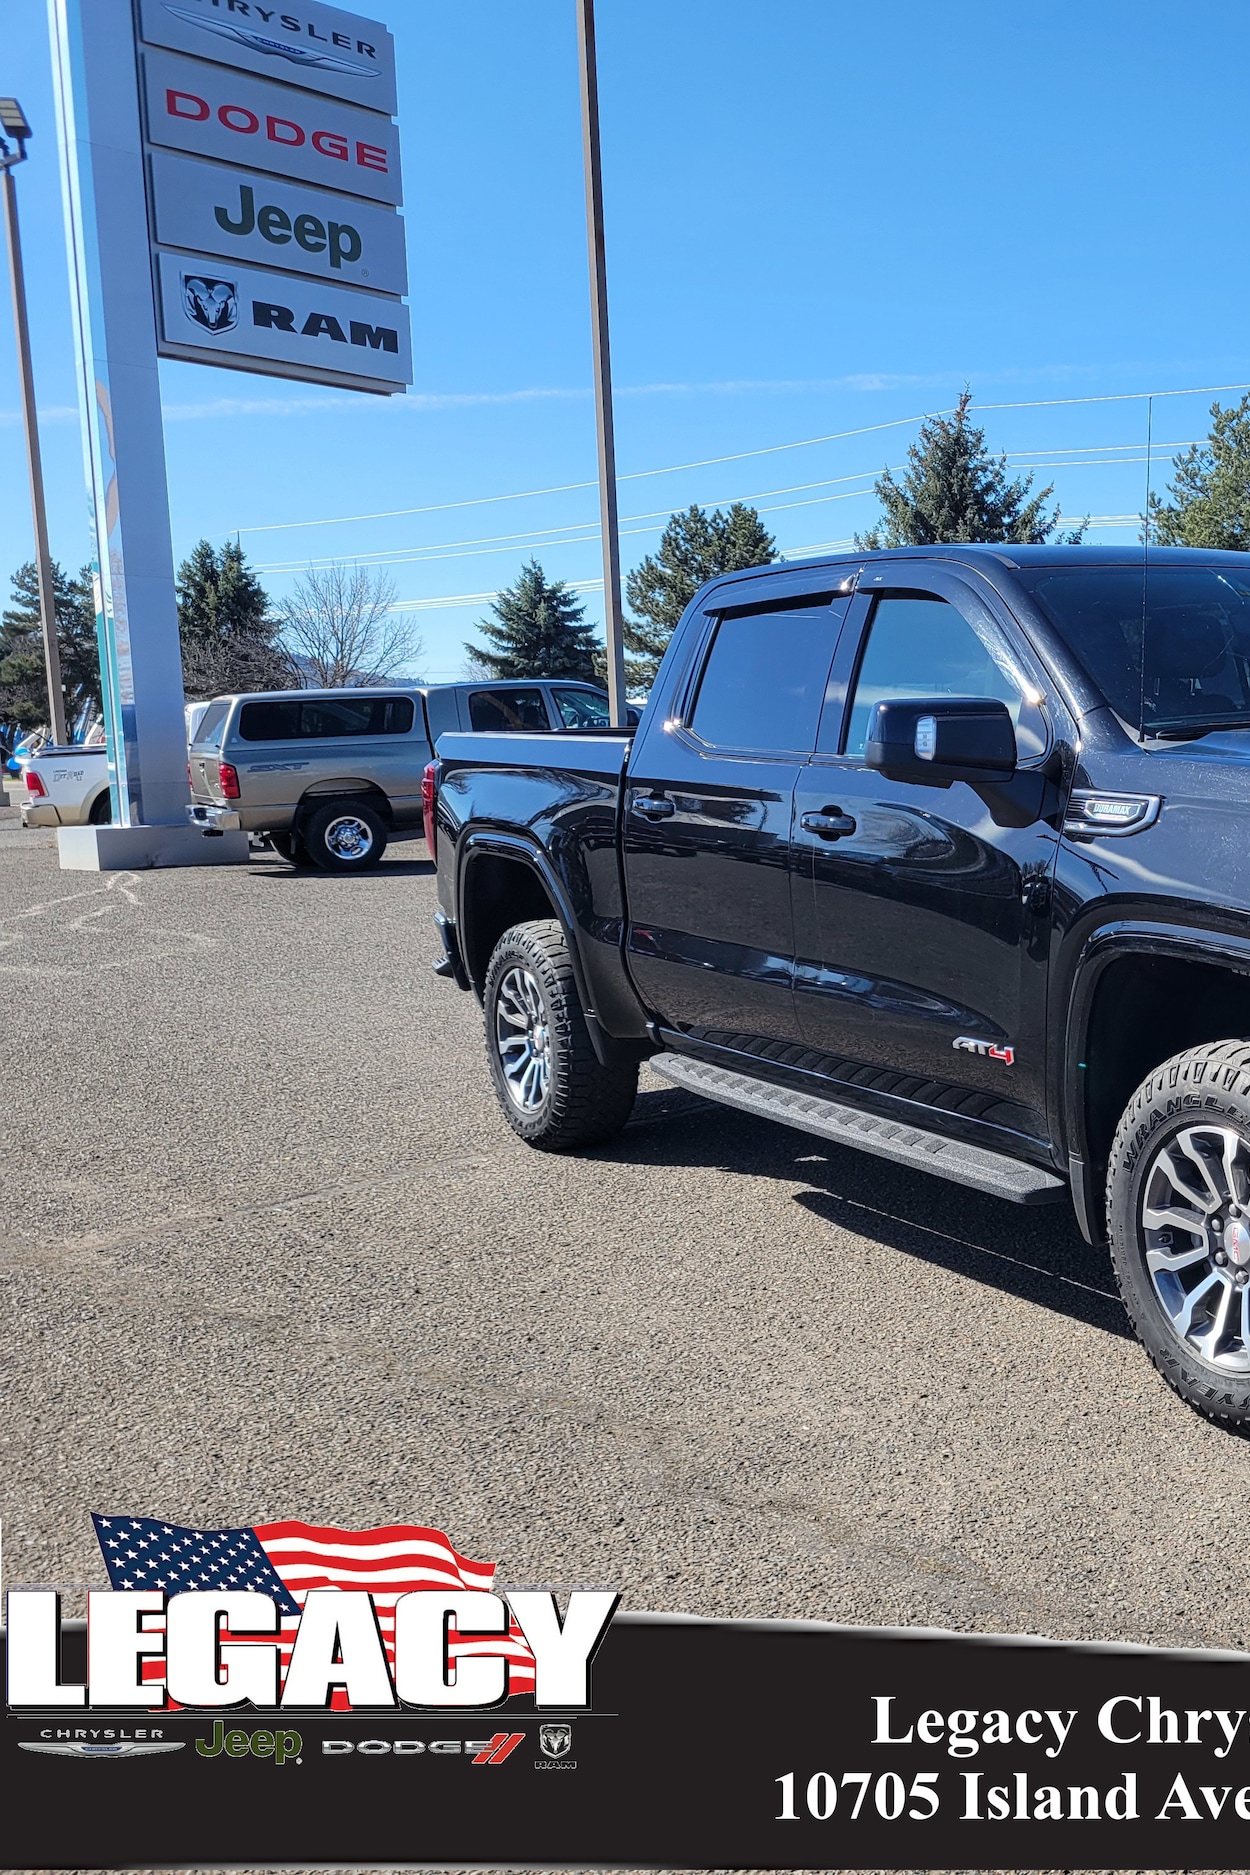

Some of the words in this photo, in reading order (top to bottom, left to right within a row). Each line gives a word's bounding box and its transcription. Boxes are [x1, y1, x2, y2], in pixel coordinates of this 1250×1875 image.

[196, 0, 377, 59] RYSLER
[166, 88, 389, 173] DODGE
[214, 185, 362, 269] Jeep
[252, 300, 399, 354] RAM
[247, 762, 310, 773] SXT
[1093, 803, 1132, 815] DURAMAX
[952, 1036, 1015, 1066] AT4
[1231, 1226, 1241, 1262] GMC
